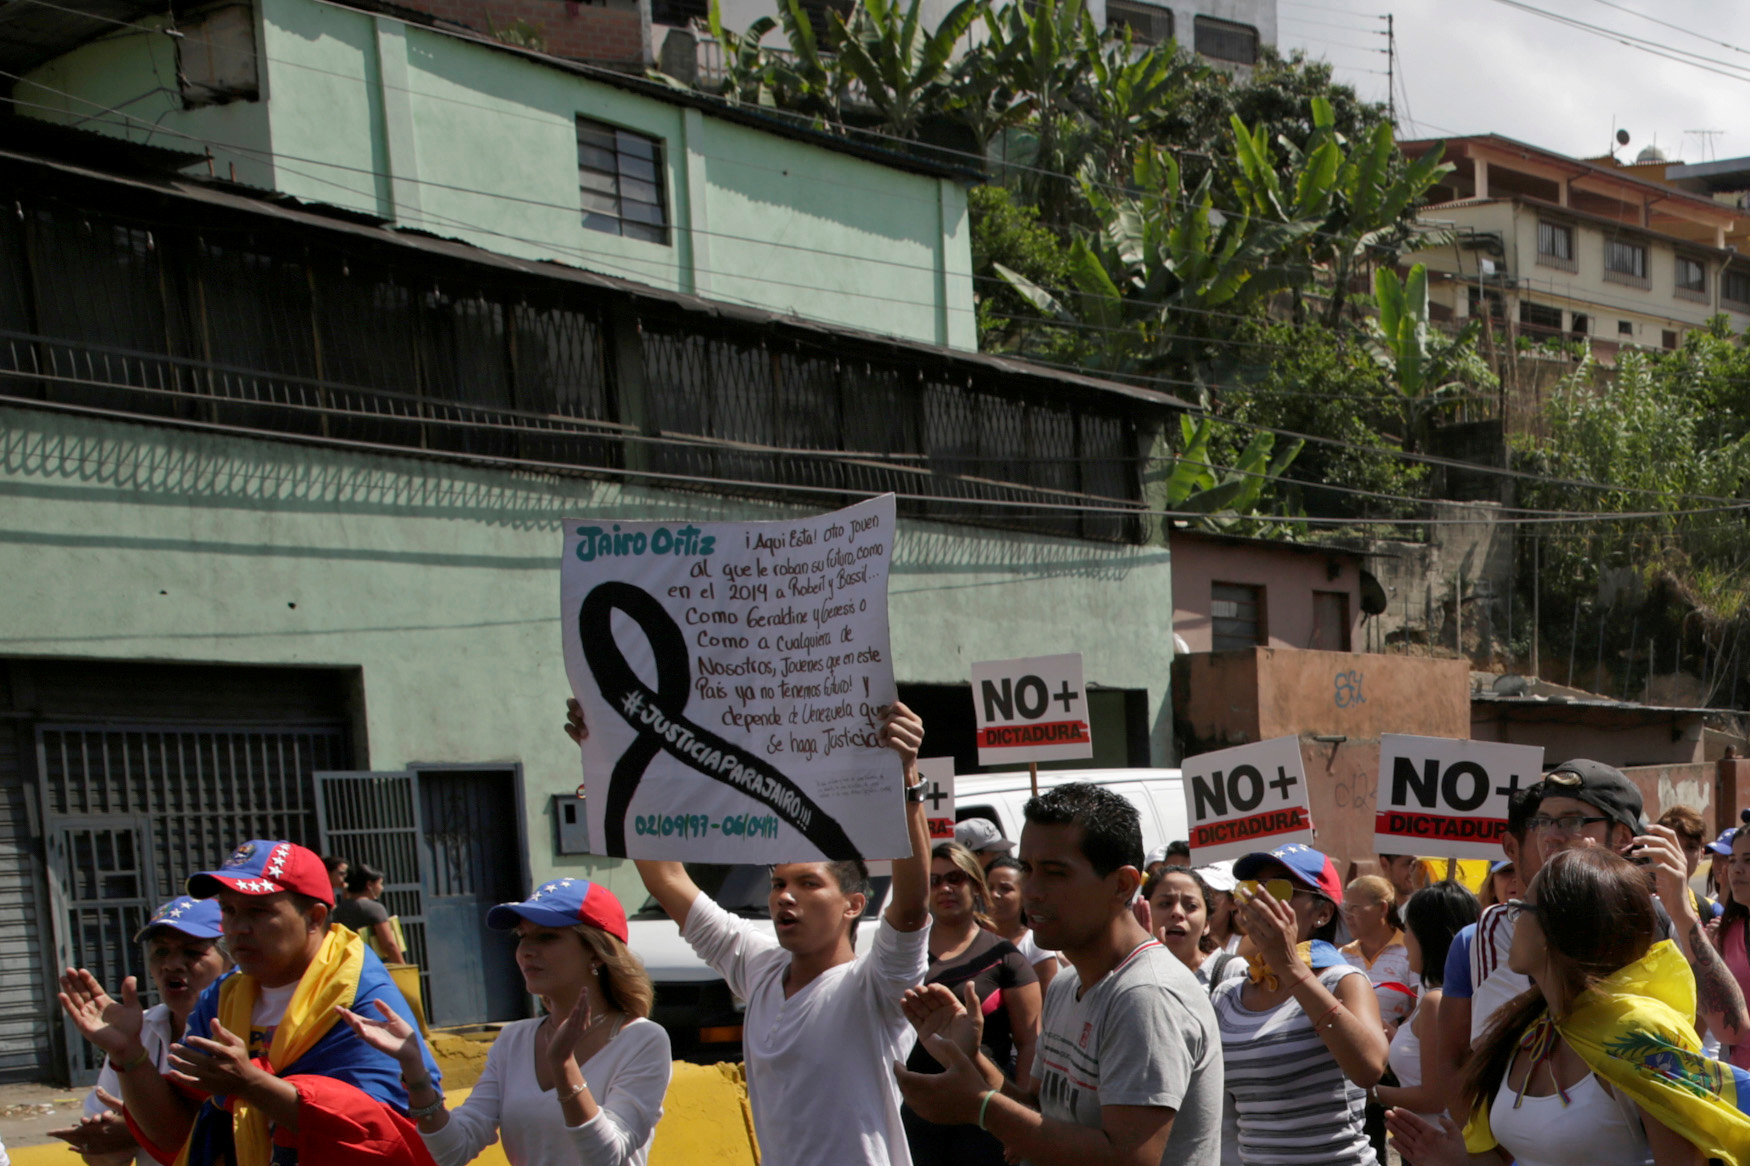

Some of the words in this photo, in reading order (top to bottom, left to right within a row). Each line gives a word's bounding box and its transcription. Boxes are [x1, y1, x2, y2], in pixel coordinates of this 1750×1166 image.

[651, 524, 716, 556] Ortiz
[722, 563, 752, 583] que
[757, 557, 768, 578] le
[773, 557, 808, 575] roban
[811, 560, 824, 574] su
[668, 585, 691, 600] en
[700, 582, 715, 600] el
[729, 584, 767, 602] 2014
[776, 588, 786, 599] a
[758, 641, 770, 650] a
[840, 625, 854, 643] de
[857, 646, 882, 663] este
[735, 685, 757, 708] ya
[760, 686, 775, 699] no
[721, 705, 783, 733] depende
[789, 731, 818, 761] haga
[986, 724, 1083, 746] DICTADURA
[1198, 810, 1303, 845] DICTADURA
[1389, 814, 1509, 840] DICTADUR
